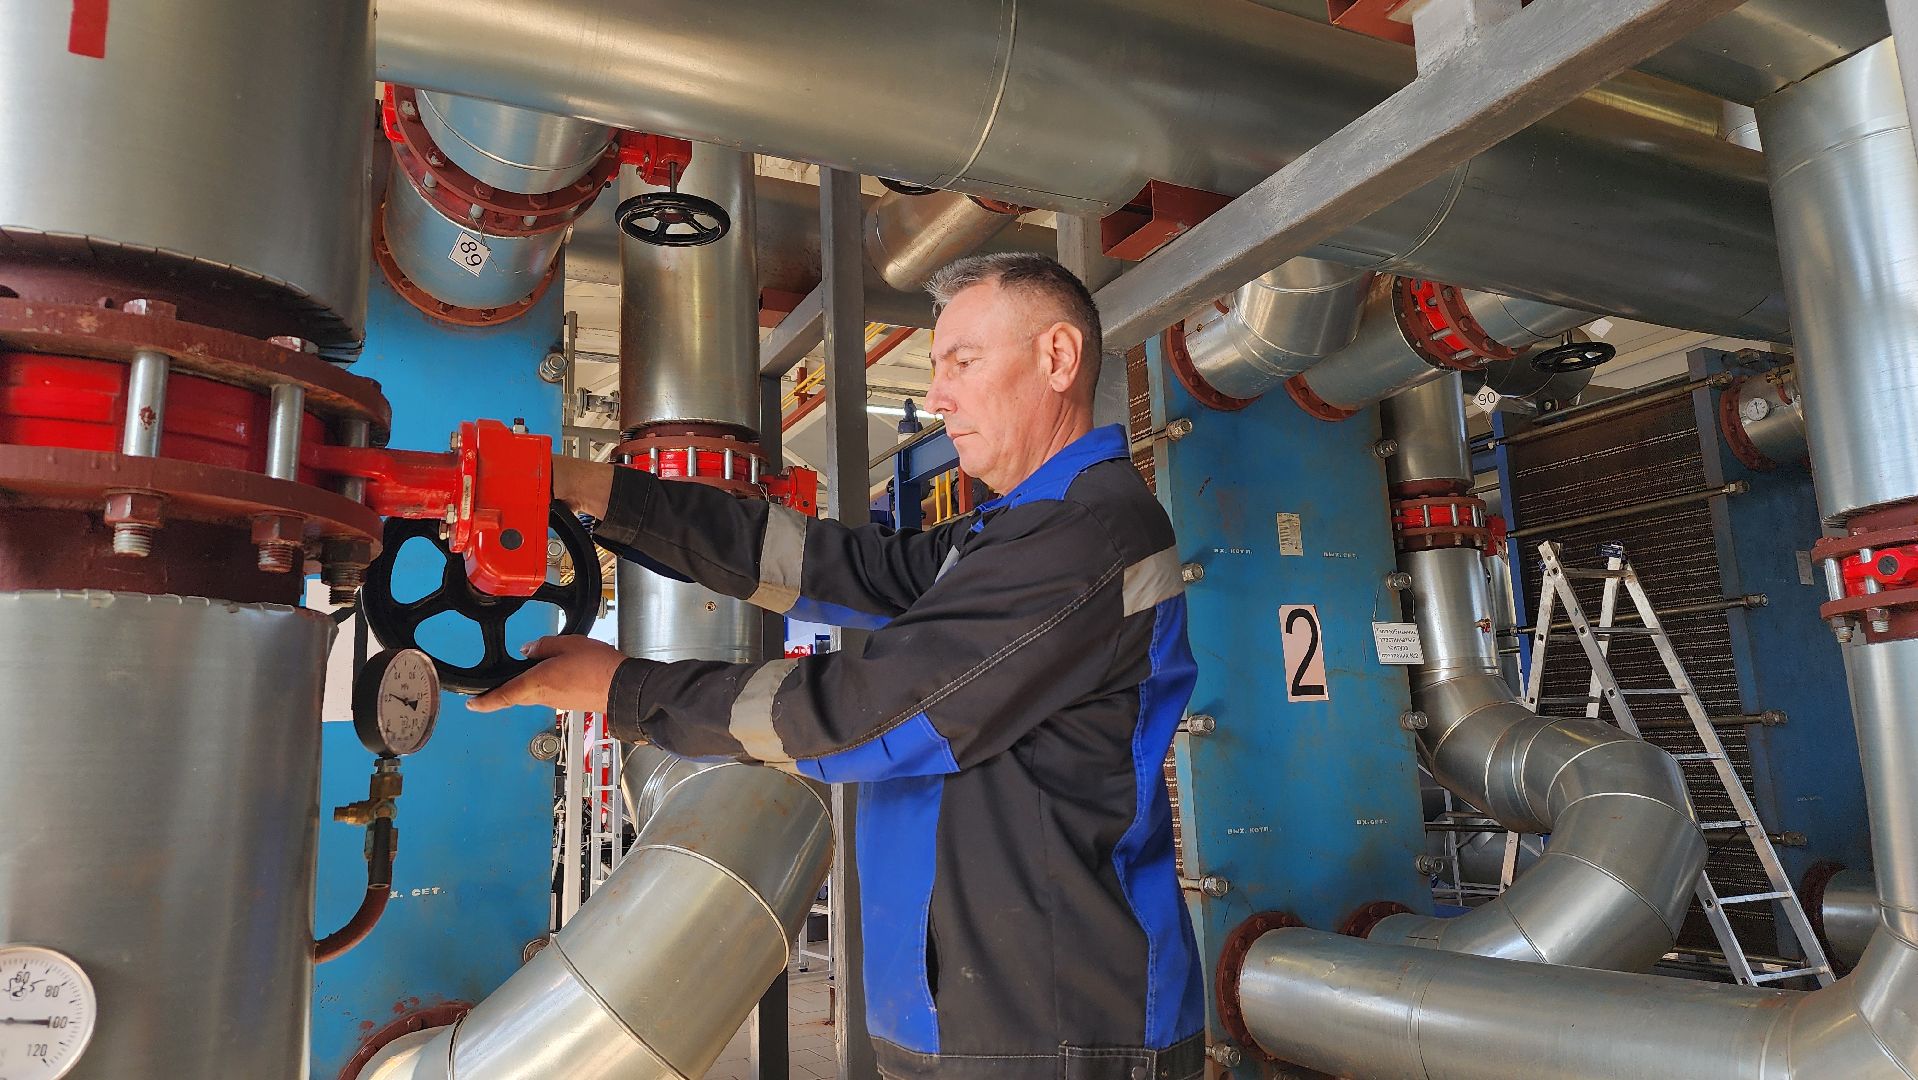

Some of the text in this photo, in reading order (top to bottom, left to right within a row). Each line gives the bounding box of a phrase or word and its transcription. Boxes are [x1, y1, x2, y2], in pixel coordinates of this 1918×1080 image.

[1479, 392, 1496, 405] 90
[1286, 608, 1325, 696] 2
[45, 985, 60, 998] 80
[46, 1016, 68, 1029] 100
[27, 1043, 48, 1057] 120
